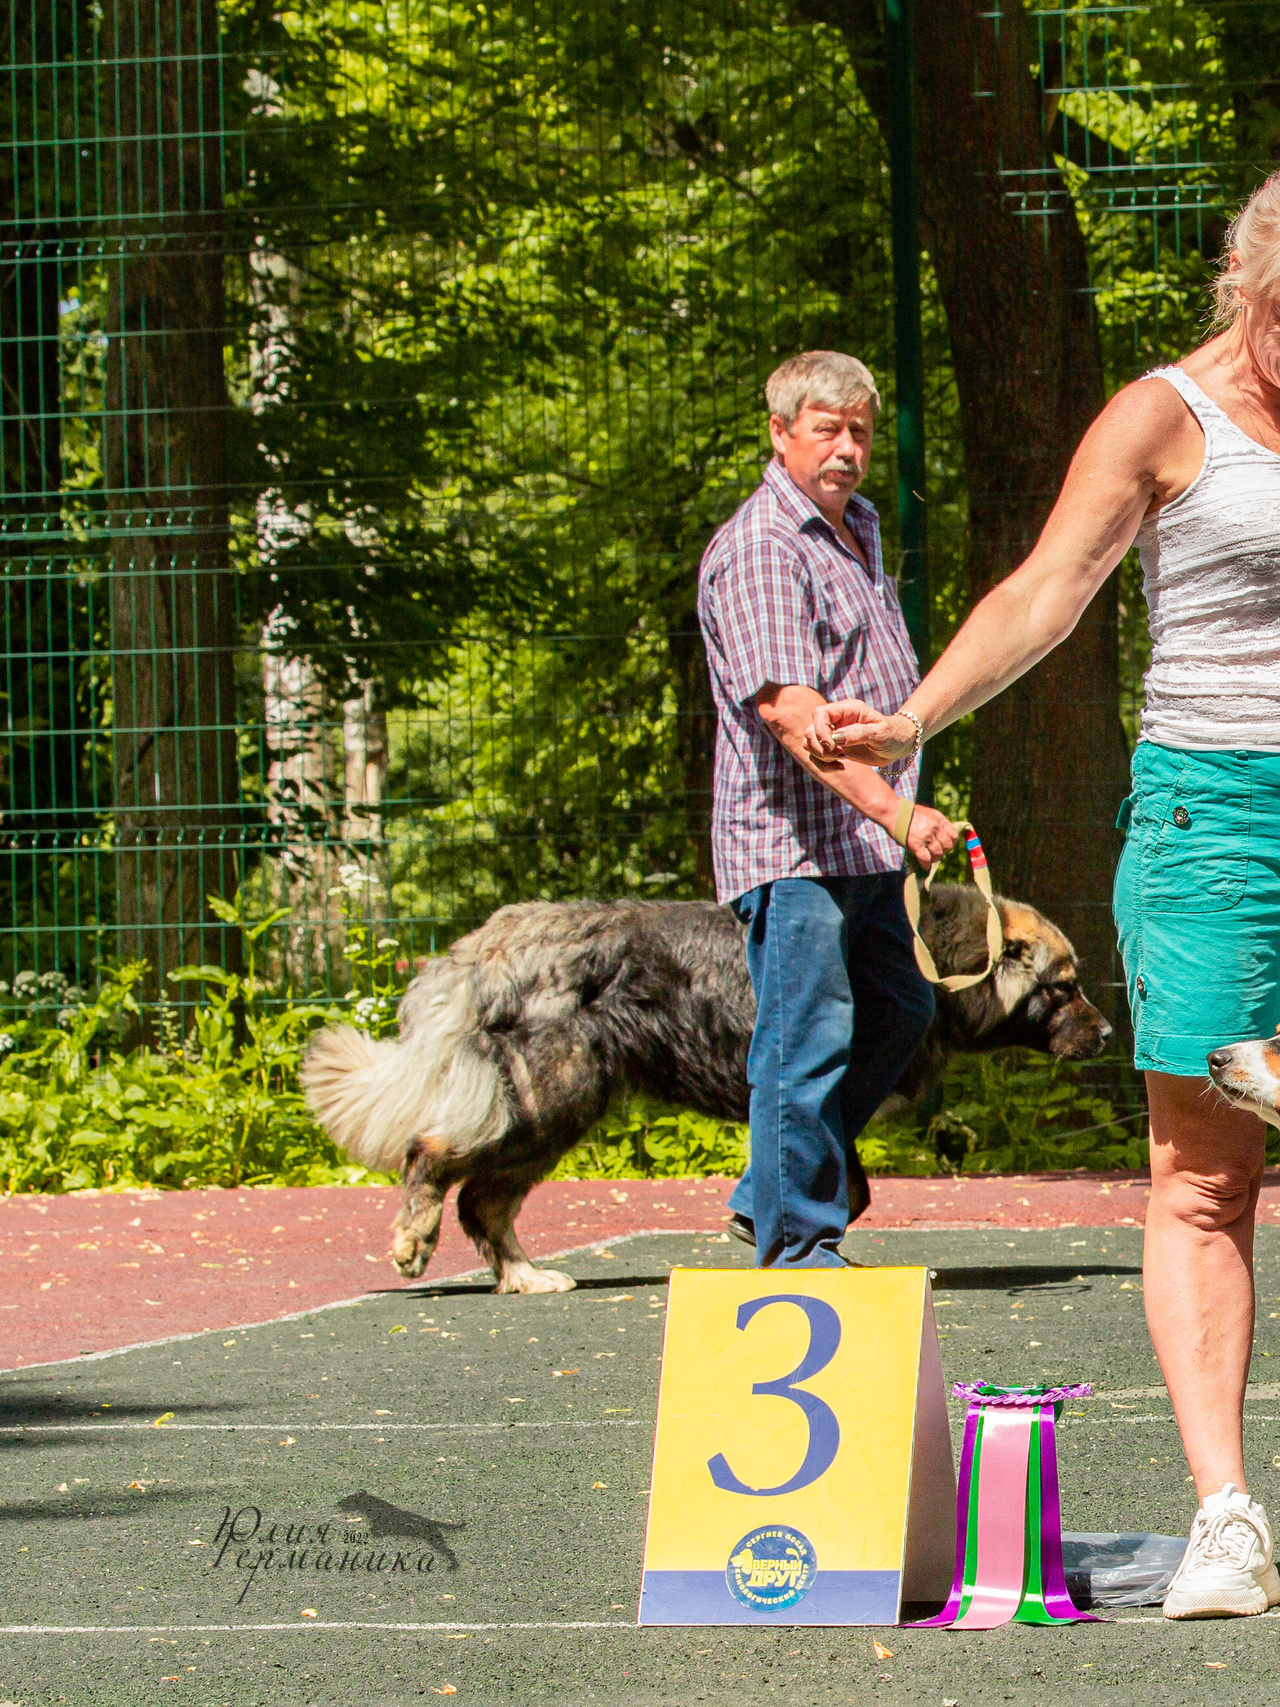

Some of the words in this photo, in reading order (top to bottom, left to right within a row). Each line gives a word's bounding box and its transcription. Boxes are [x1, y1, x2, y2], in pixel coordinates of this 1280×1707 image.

[707, 1293, 842, 1496] 3
[746, 1530, 783, 1548] СЕРГИЕВ
[784, 1533, 808, 1556] ПОСАД
[753, 1559, 804, 1571] ВЕРНЫЙ
[734, 1567, 796, 1605] КИНОЛОГИЧЕСКИЙ
[795, 1563, 810, 1591] ЦЕНТР
[746, 1570, 802, 1588] ДРУГ
